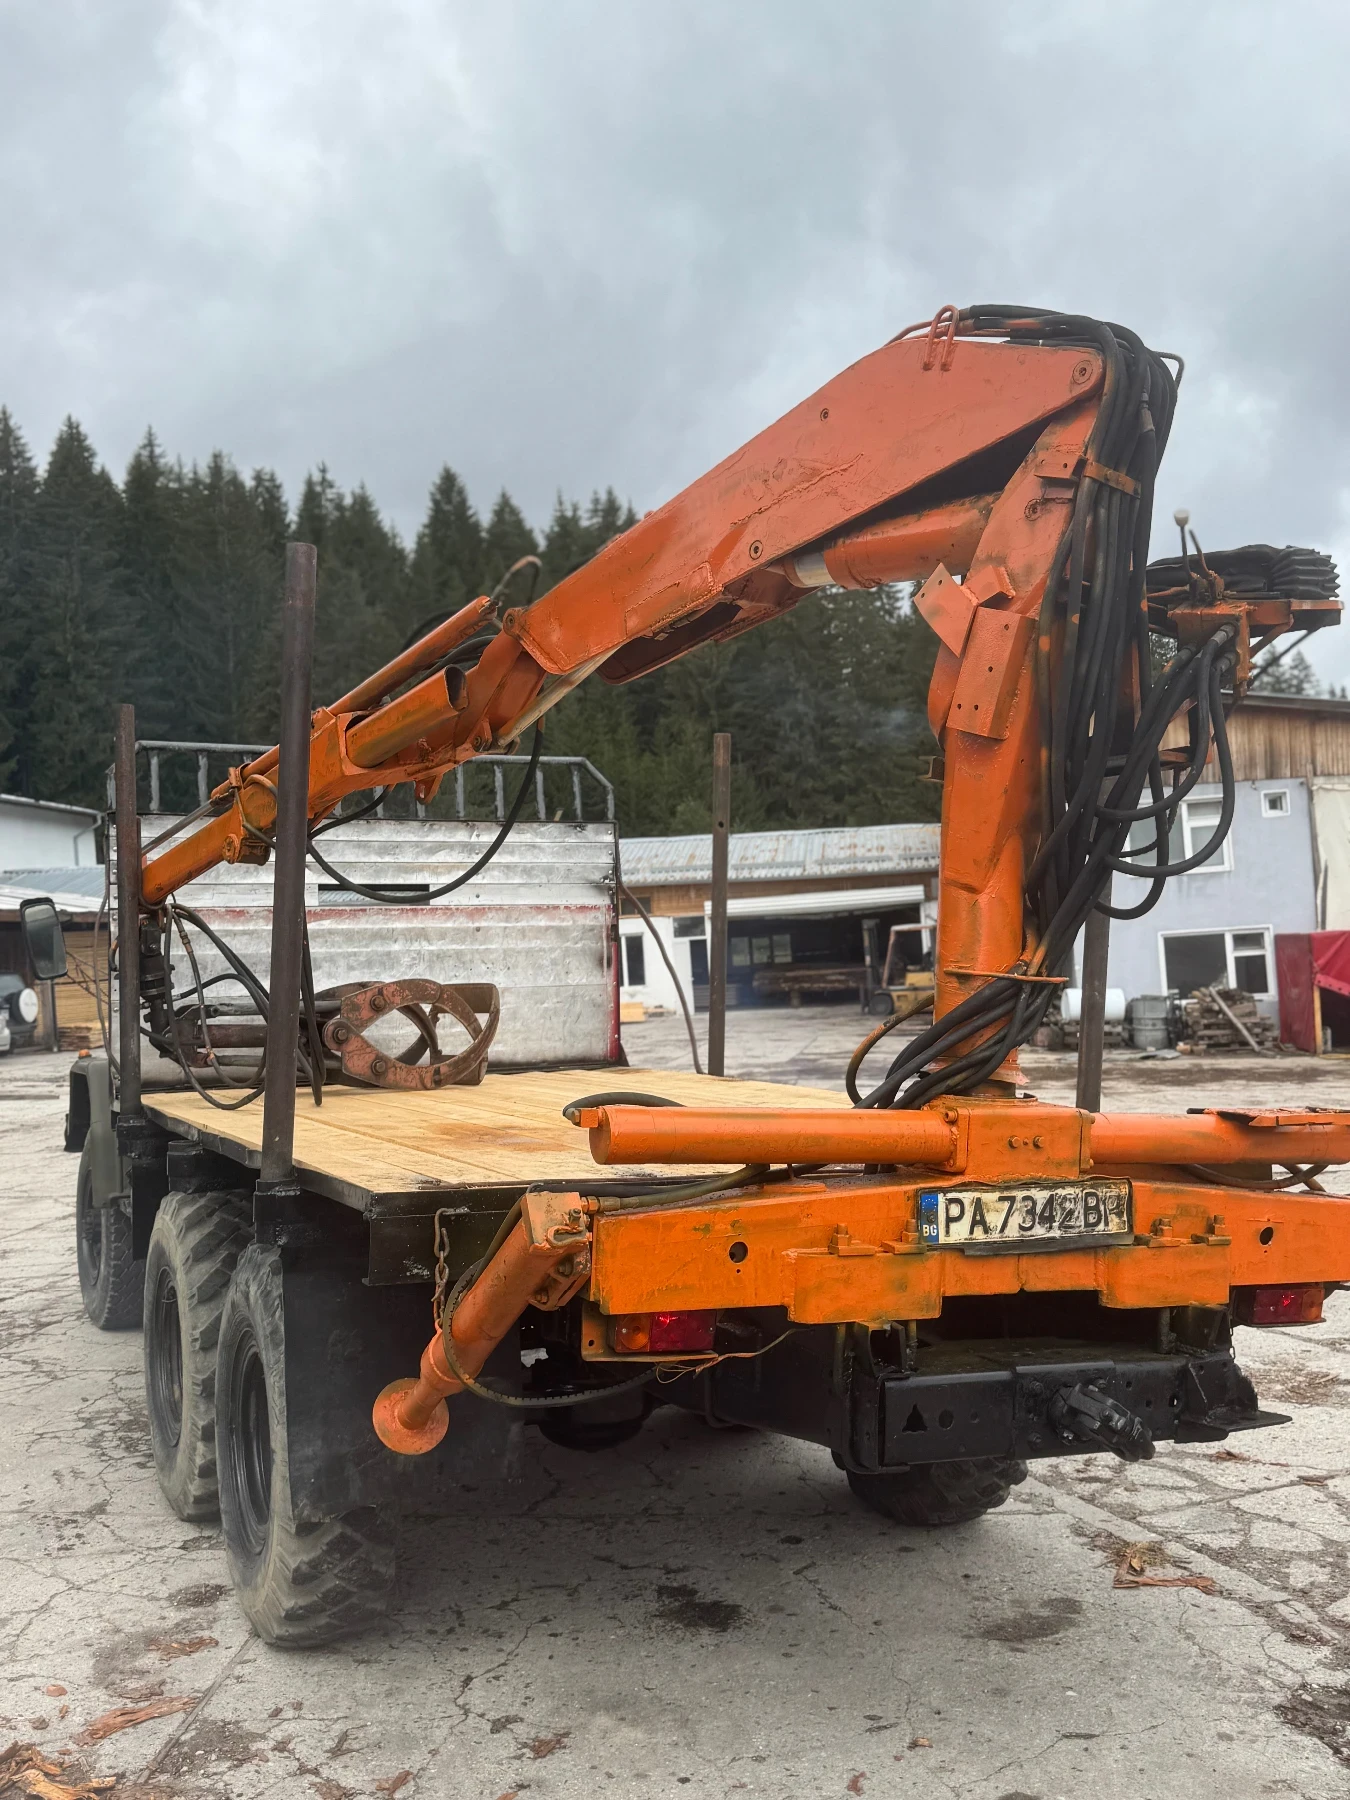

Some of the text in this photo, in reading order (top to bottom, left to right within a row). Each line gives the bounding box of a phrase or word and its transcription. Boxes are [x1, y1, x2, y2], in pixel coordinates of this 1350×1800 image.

[945, 1197, 989, 1237] PA
[997, 1192, 1079, 1234] 7342
[922, 1224, 938, 1237] BG
